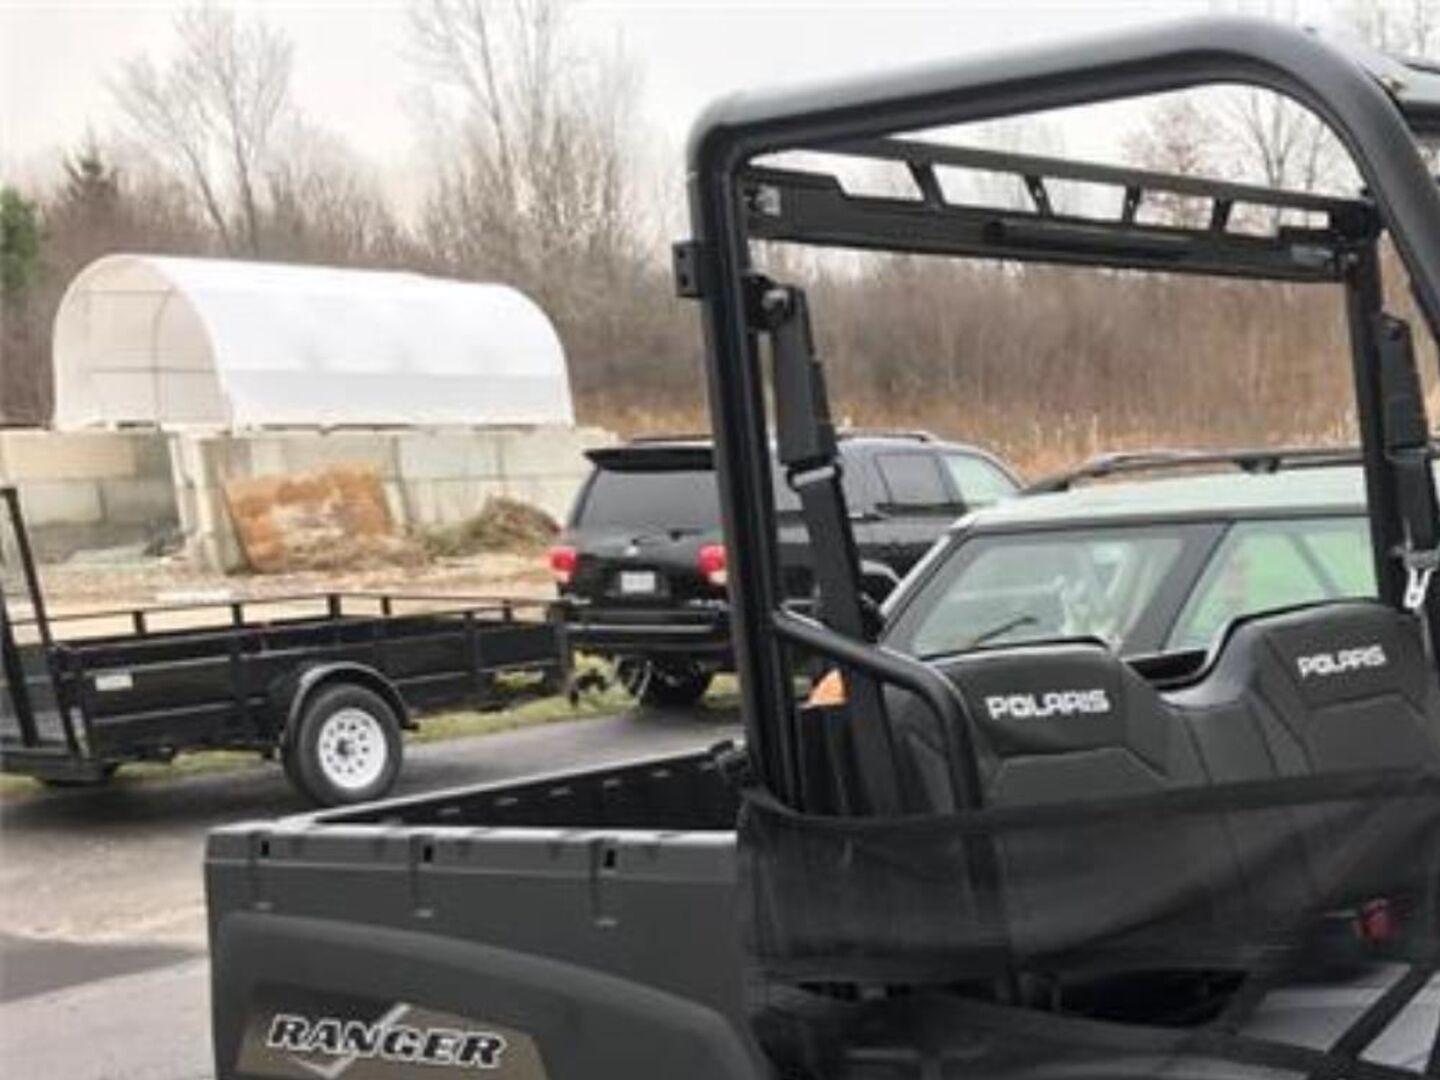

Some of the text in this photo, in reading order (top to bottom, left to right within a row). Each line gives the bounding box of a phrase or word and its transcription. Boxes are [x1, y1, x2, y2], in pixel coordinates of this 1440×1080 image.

[1297, 644, 1386, 679] POLARIS
[985, 689, 1110, 719] POLARIS
[266, 1013, 507, 1068] RANGER
